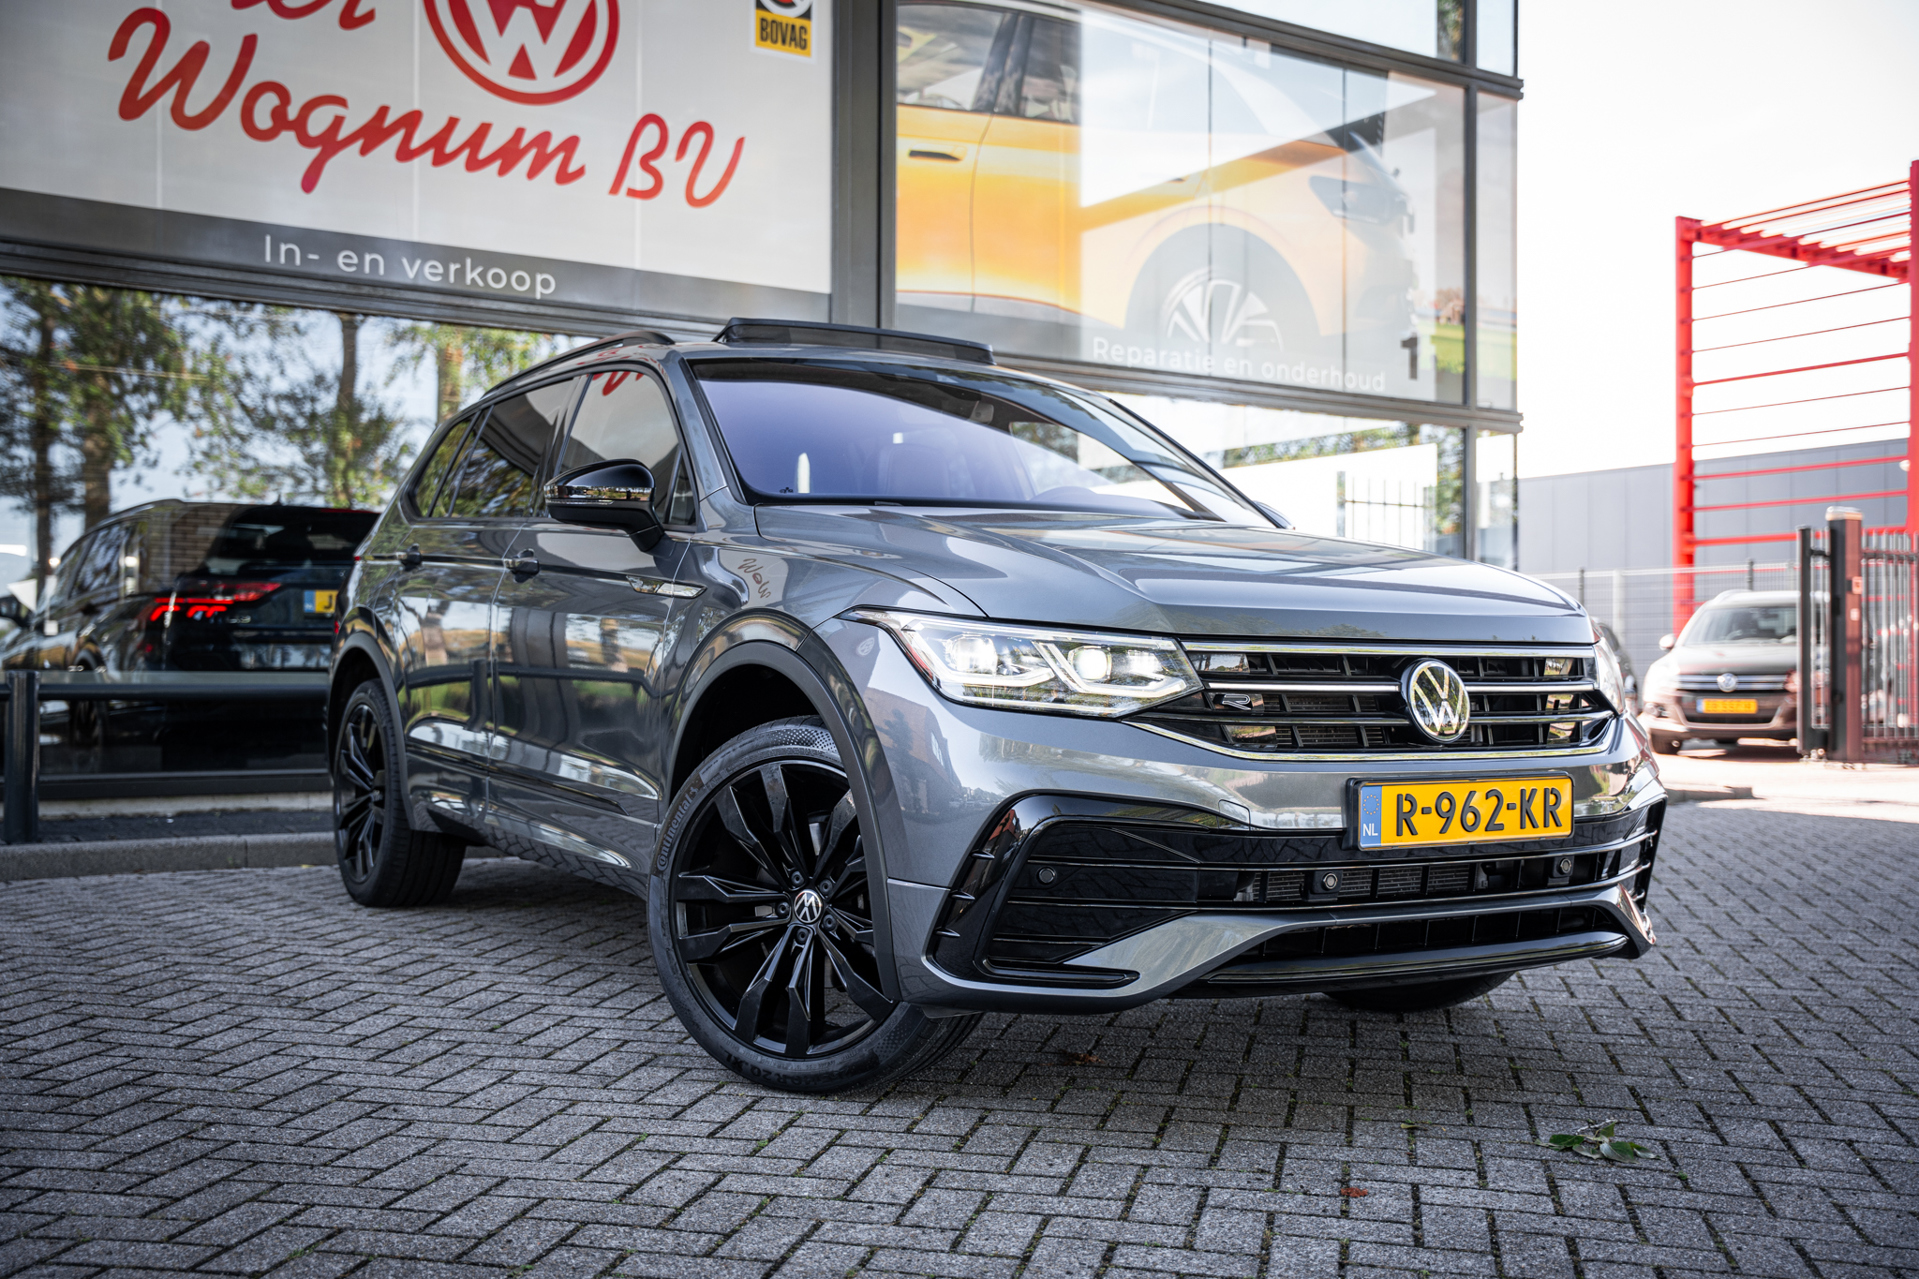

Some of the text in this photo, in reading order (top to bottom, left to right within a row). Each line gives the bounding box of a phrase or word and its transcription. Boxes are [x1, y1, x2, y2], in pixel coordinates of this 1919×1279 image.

[760, 17, 808, 51] BOVAG
[108, 8, 586, 194] Wognum
[265, 235, 558, 298] In- en verkoop
[1092, 337, 1387, 392] Reparatie en onderhoud
[656, 792, 694, 871] Continental
[1362, 823, 1379, 837] NL
[1396, 787, 1563, 837] R-962-KR
